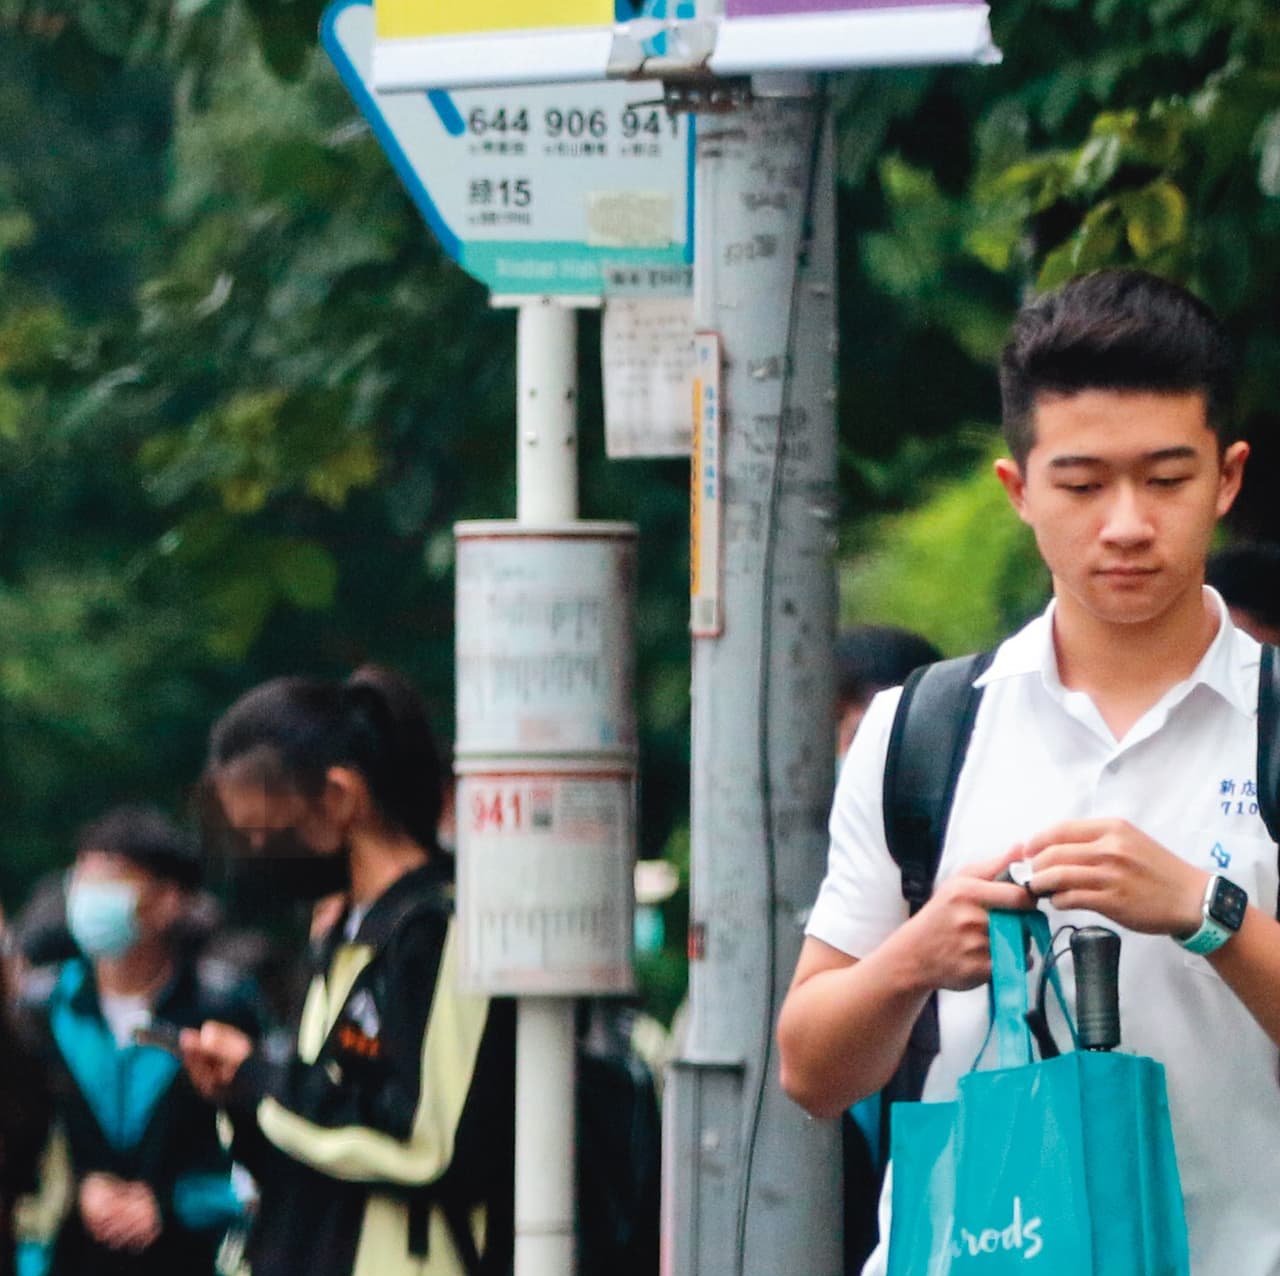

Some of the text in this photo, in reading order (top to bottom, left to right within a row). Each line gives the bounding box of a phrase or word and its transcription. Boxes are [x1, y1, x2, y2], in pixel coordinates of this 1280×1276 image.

[470, 107, 679, 139] 644 906 941
[472, 790, 522, 831] 941
